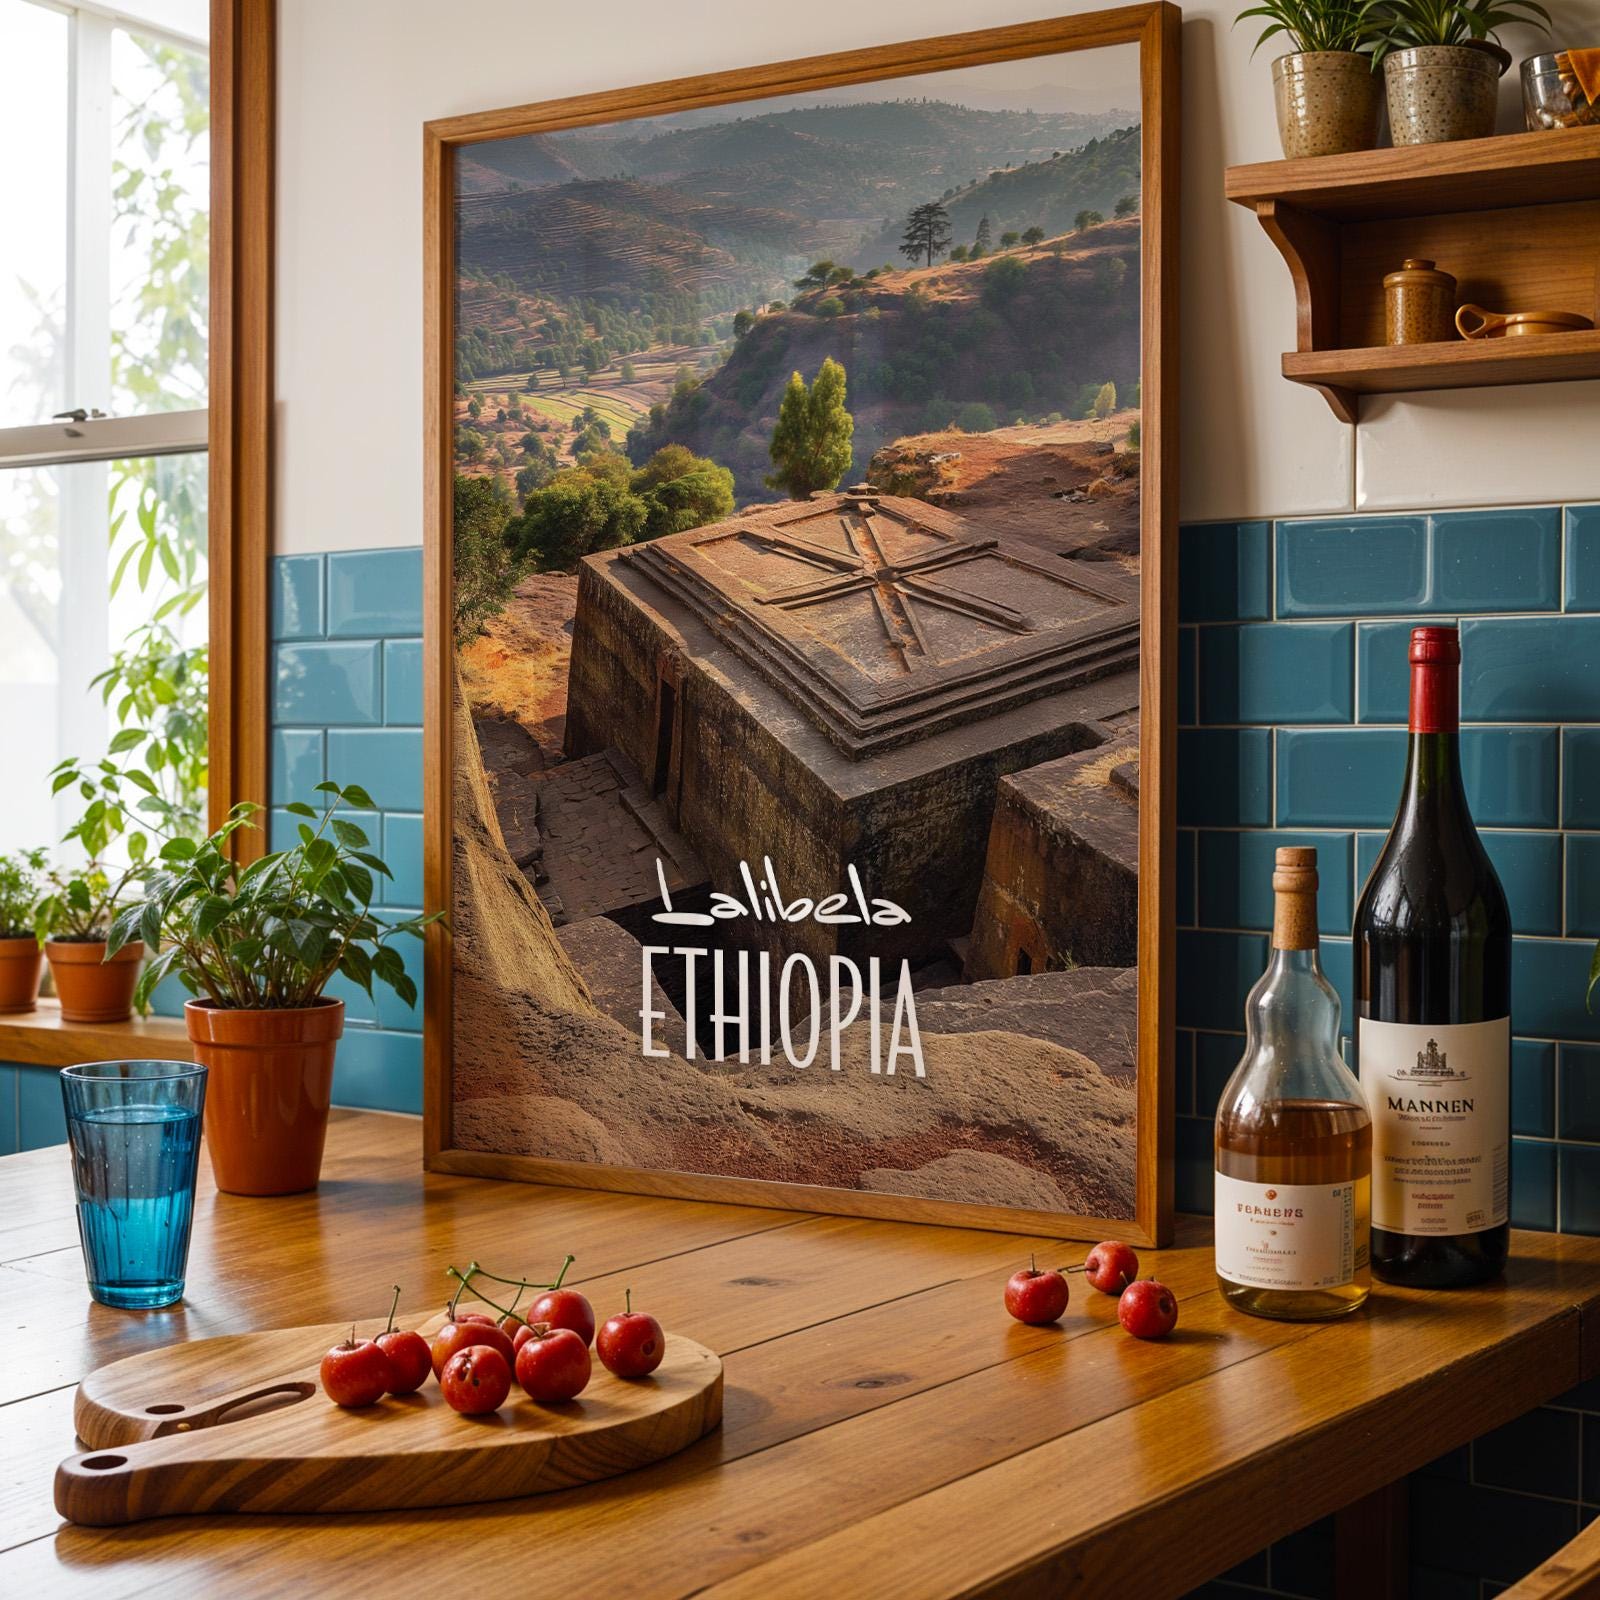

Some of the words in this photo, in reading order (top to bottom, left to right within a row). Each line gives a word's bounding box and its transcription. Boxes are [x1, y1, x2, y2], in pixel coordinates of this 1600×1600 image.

[651, 855, 912, 926] Lalibela
[638, 945, 926, 1078] ETHIOPIA
[1387, 1096, 1475, 1113] MANNEN
